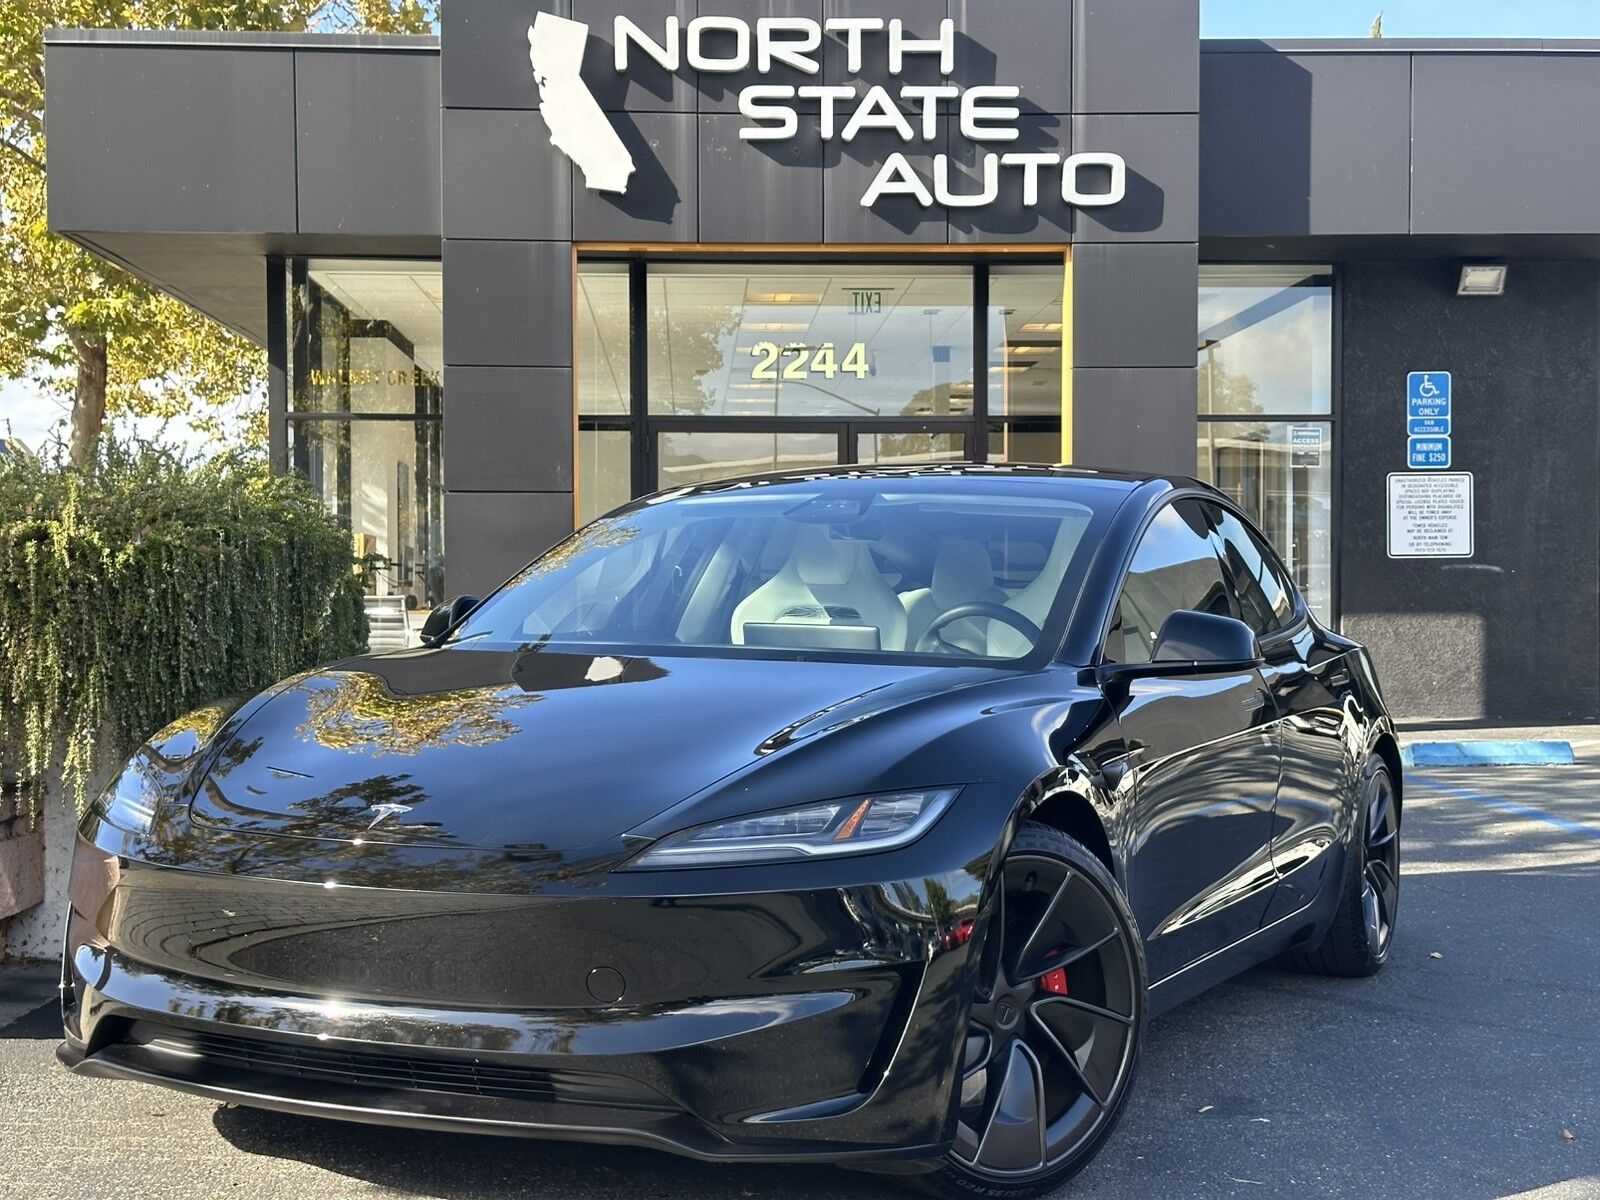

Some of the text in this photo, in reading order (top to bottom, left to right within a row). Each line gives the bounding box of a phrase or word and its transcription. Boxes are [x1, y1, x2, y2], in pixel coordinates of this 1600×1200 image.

[613, 15, 955, 76] NORTH
[738, 85, 1020, 142] STATE
[860, 152, 1126, 208] AUTO
[750, 341, 870, 380] 2244
[311, 369, 440, 386] WALNUT CREEK
[1411, 397, 1447, 405] PARKING
[1418, 408, 1440, 416] ONLY
[1415, 442, 1443, 451] MINIMUM
[1412, 453, 1446, 462] FINE $250
